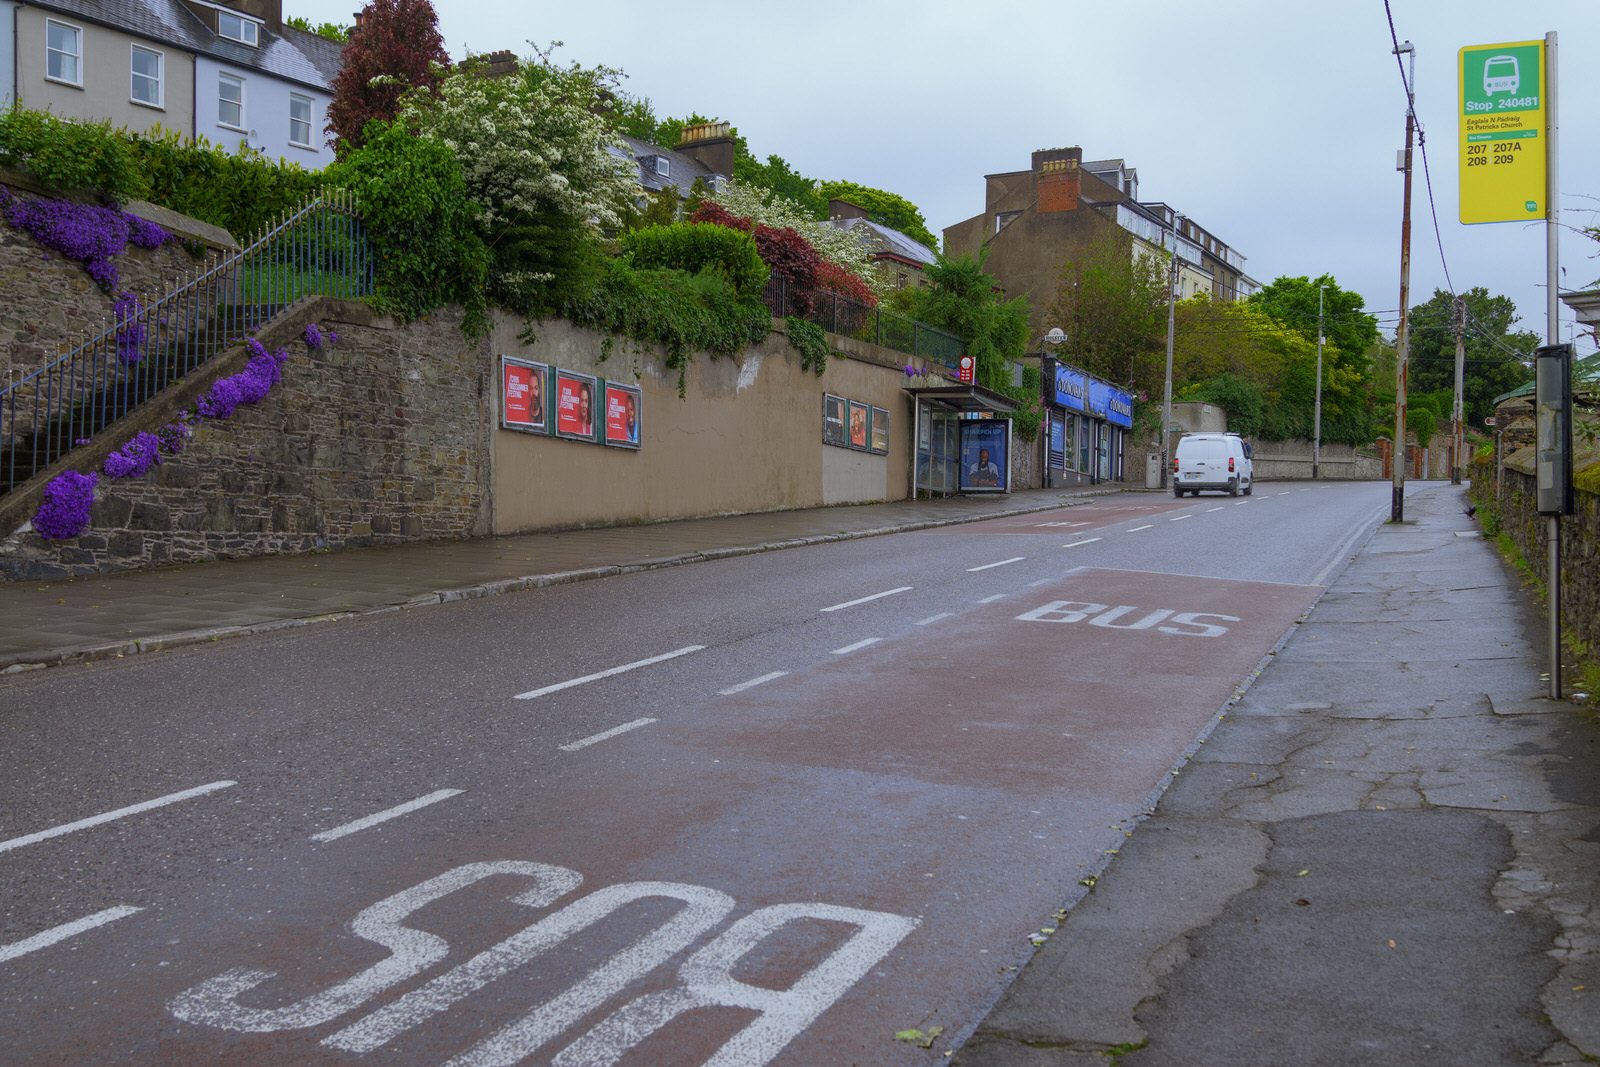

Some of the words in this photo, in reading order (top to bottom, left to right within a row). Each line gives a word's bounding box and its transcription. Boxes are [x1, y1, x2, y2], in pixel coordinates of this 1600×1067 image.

[1466, 101, 1493, 112] Stop
[1498, 96, 1538, 108] 240481
[1467, 144, 1487, 155] 207
[1493, 141, 1522, 153] 207A
[1467, 156, 1487, 166] 208
[1494, 154, 1514, 164] 209
[1015, 600, 1241, 637] BUS
